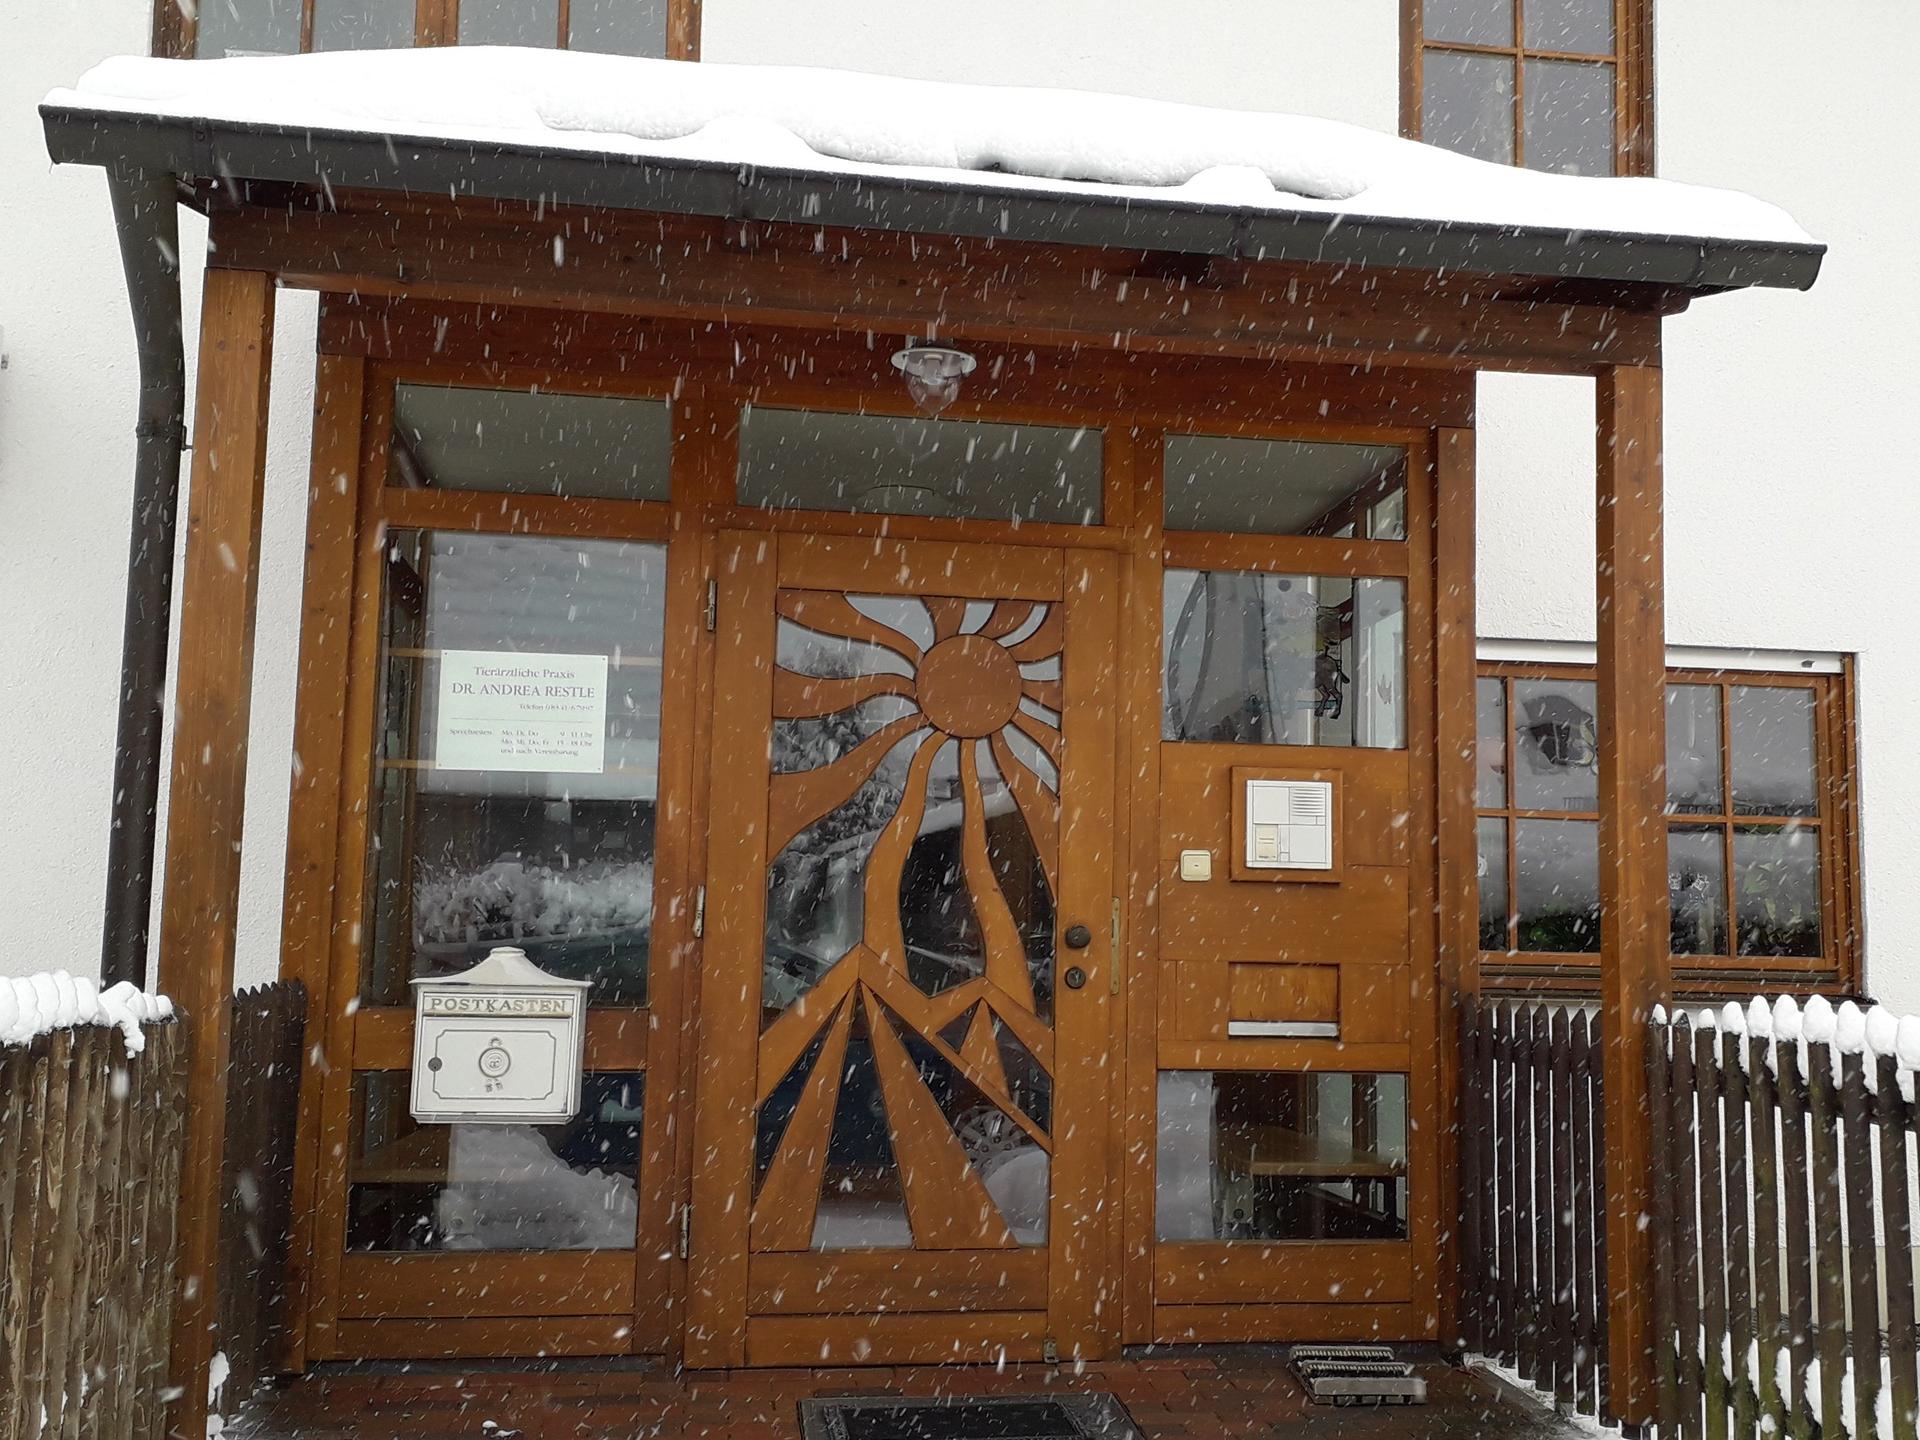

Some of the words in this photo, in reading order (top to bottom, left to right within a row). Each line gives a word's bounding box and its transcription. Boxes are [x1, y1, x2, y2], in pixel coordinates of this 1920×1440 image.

[475, 666, 540, 678] Tierärztliche
[543, 669, 575, 679] Praxis
[452, 682, 475, 695] DR.
[480, 683, 541, 697] ANDREA
[545, 686, 595, 698] RESTLE
[431, 998, 566, 1012] POSTKASTEN
